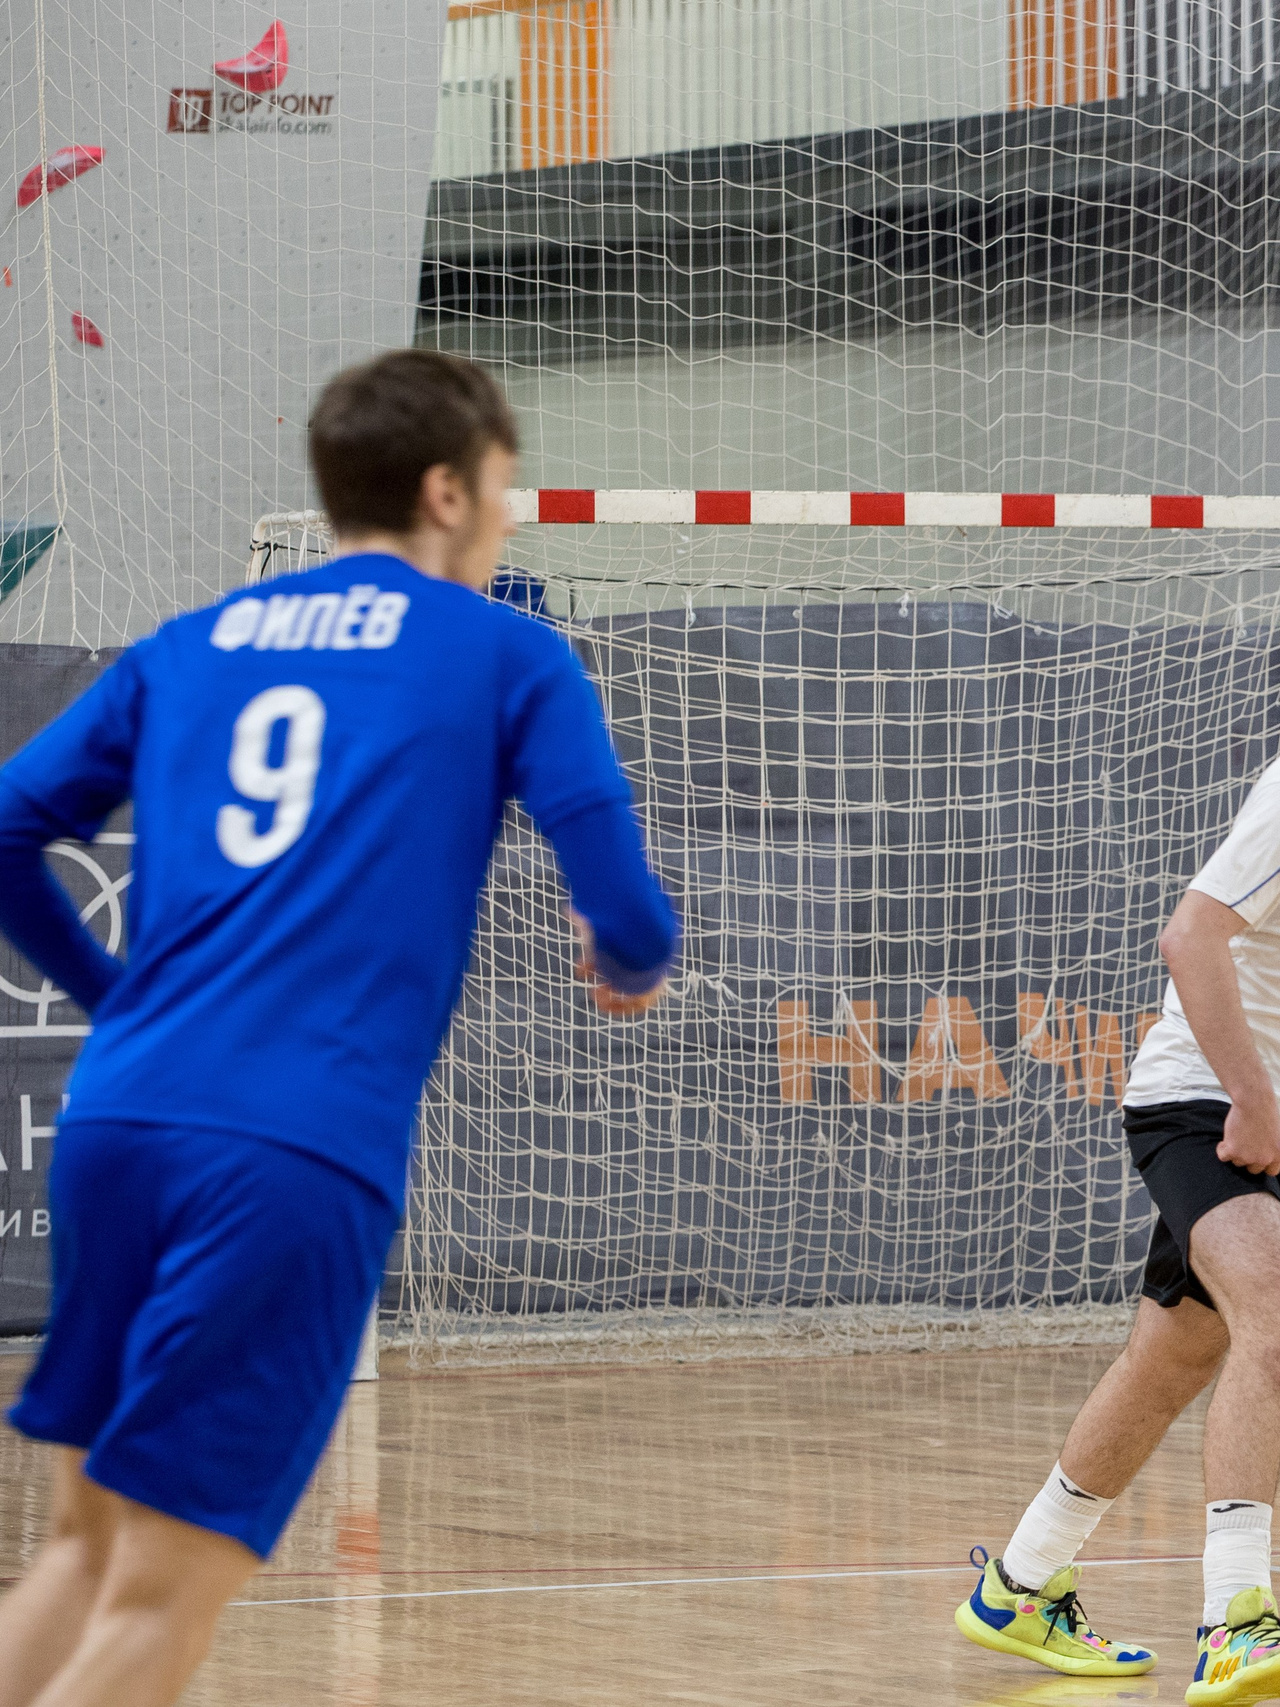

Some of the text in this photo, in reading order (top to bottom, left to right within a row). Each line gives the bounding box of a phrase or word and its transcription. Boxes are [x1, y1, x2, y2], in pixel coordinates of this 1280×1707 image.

[220, 91, 334, 115] TOP POINT
[216, 684, 327, 869] 9
